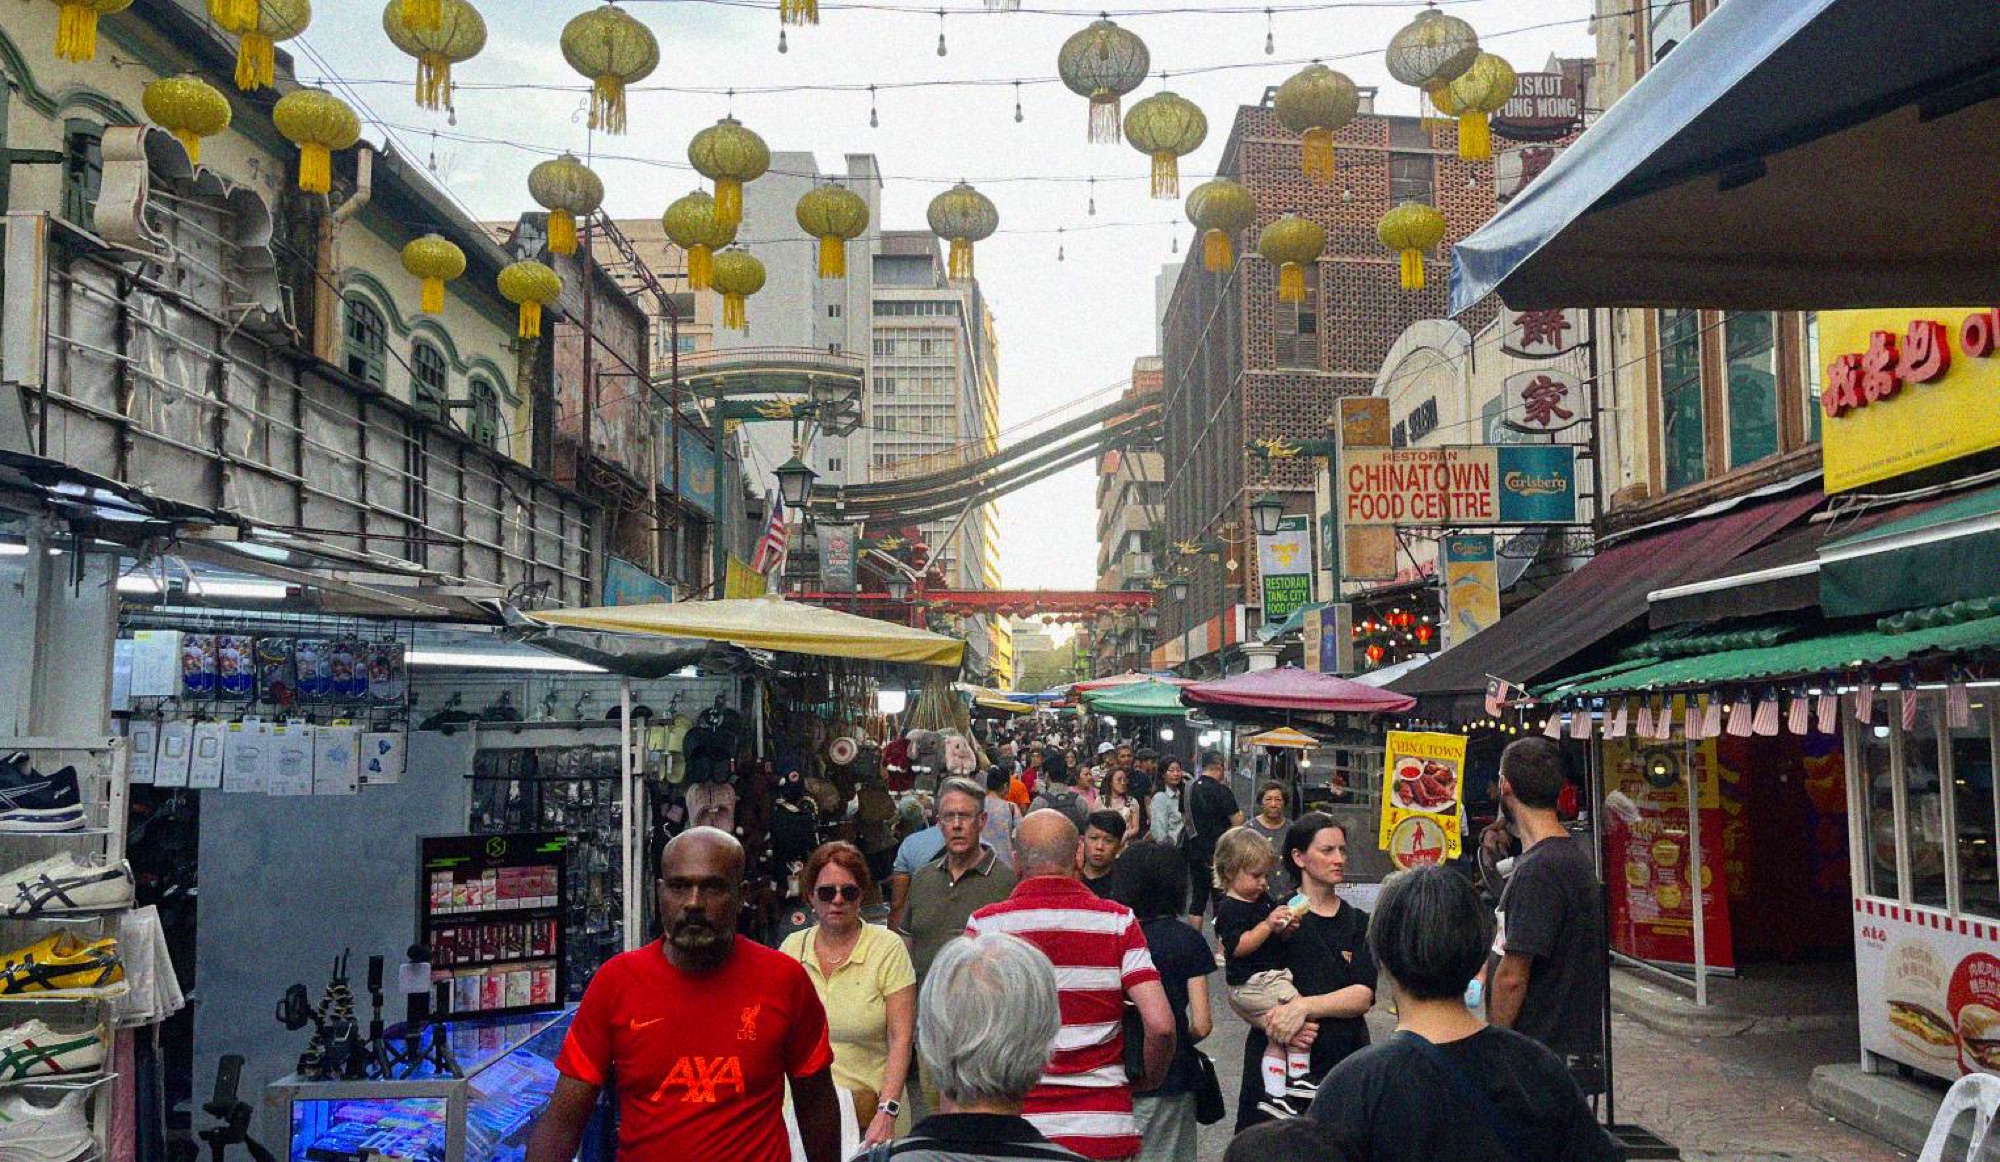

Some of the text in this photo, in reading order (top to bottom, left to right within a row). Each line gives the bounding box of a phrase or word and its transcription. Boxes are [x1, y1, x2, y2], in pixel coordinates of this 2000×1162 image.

[1537, 98, 1577, 118] WONG
[1382, 451, 1458, 461] RESTORAN
[1348, 463, 1490, 493] CHINATOWN
[1504, 471, 1568, 494] Carlsberg
[1348, 492, 1492, 520] FOOD CENTRE
[1265, 576, 1308, 590] RESTORAN
[1268, 589, 1308, 602] TANG CITY
[1268, 601, 1286, 615] FOOD
[1428, 744, 1462, 758] TOWN
[650, 1056, 745, 1103] AXA
